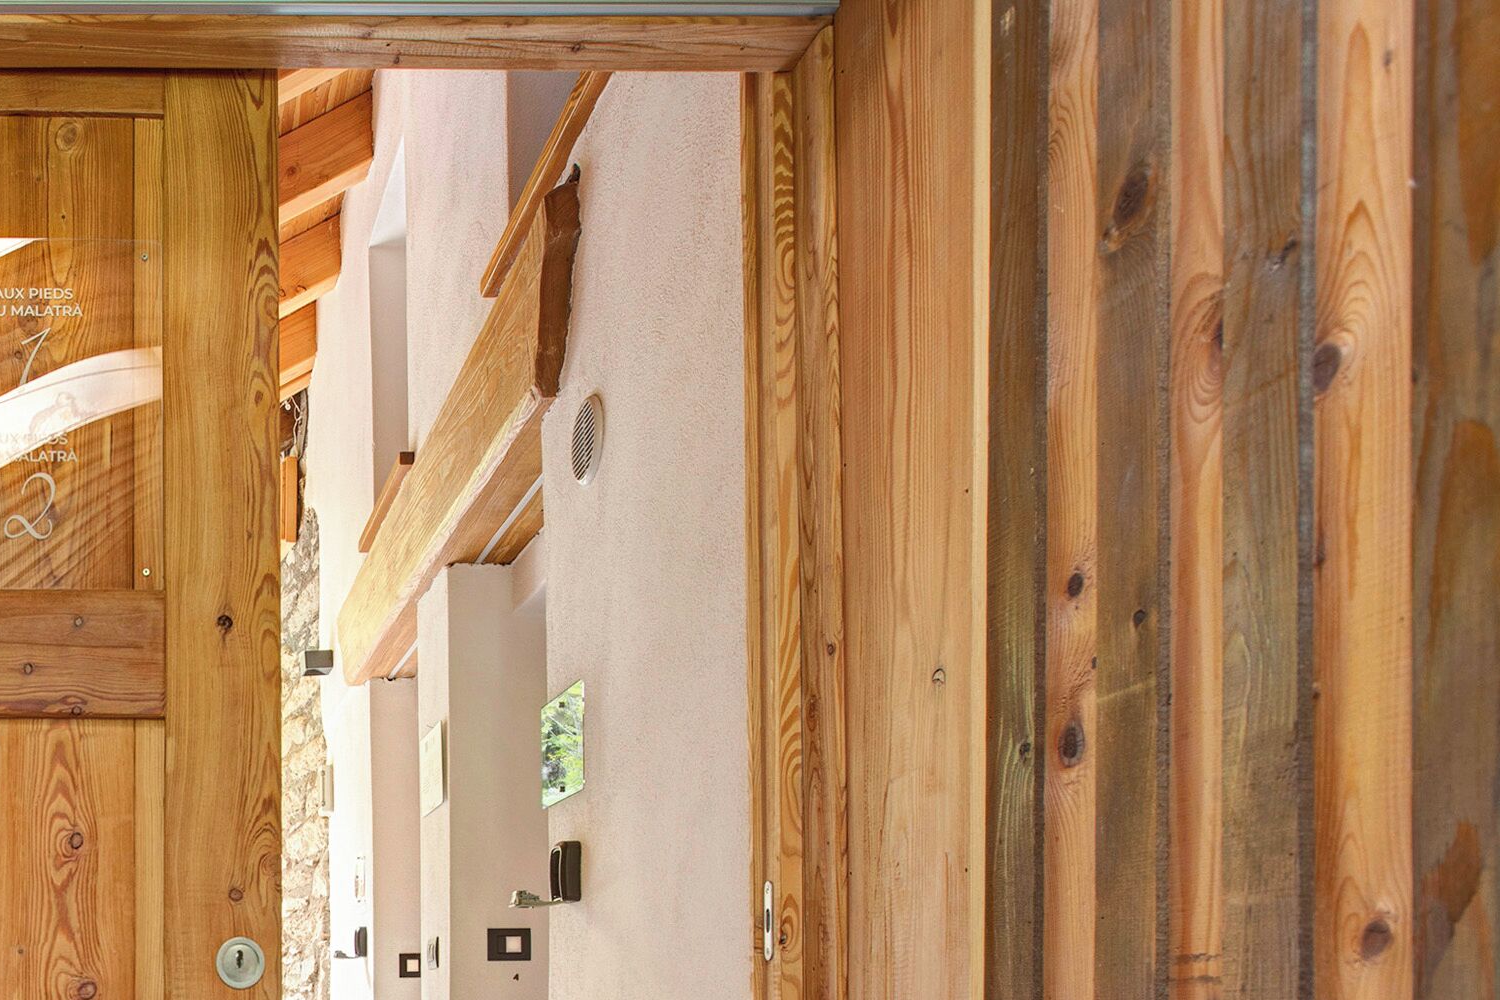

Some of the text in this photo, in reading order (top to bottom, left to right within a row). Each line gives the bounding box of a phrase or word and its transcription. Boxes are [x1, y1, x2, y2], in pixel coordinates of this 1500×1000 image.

[29, 287, 74, 300] PIEDS
[11, 302, 83, 316] MALATRÀ
[4, 472, 56, 540] 2
